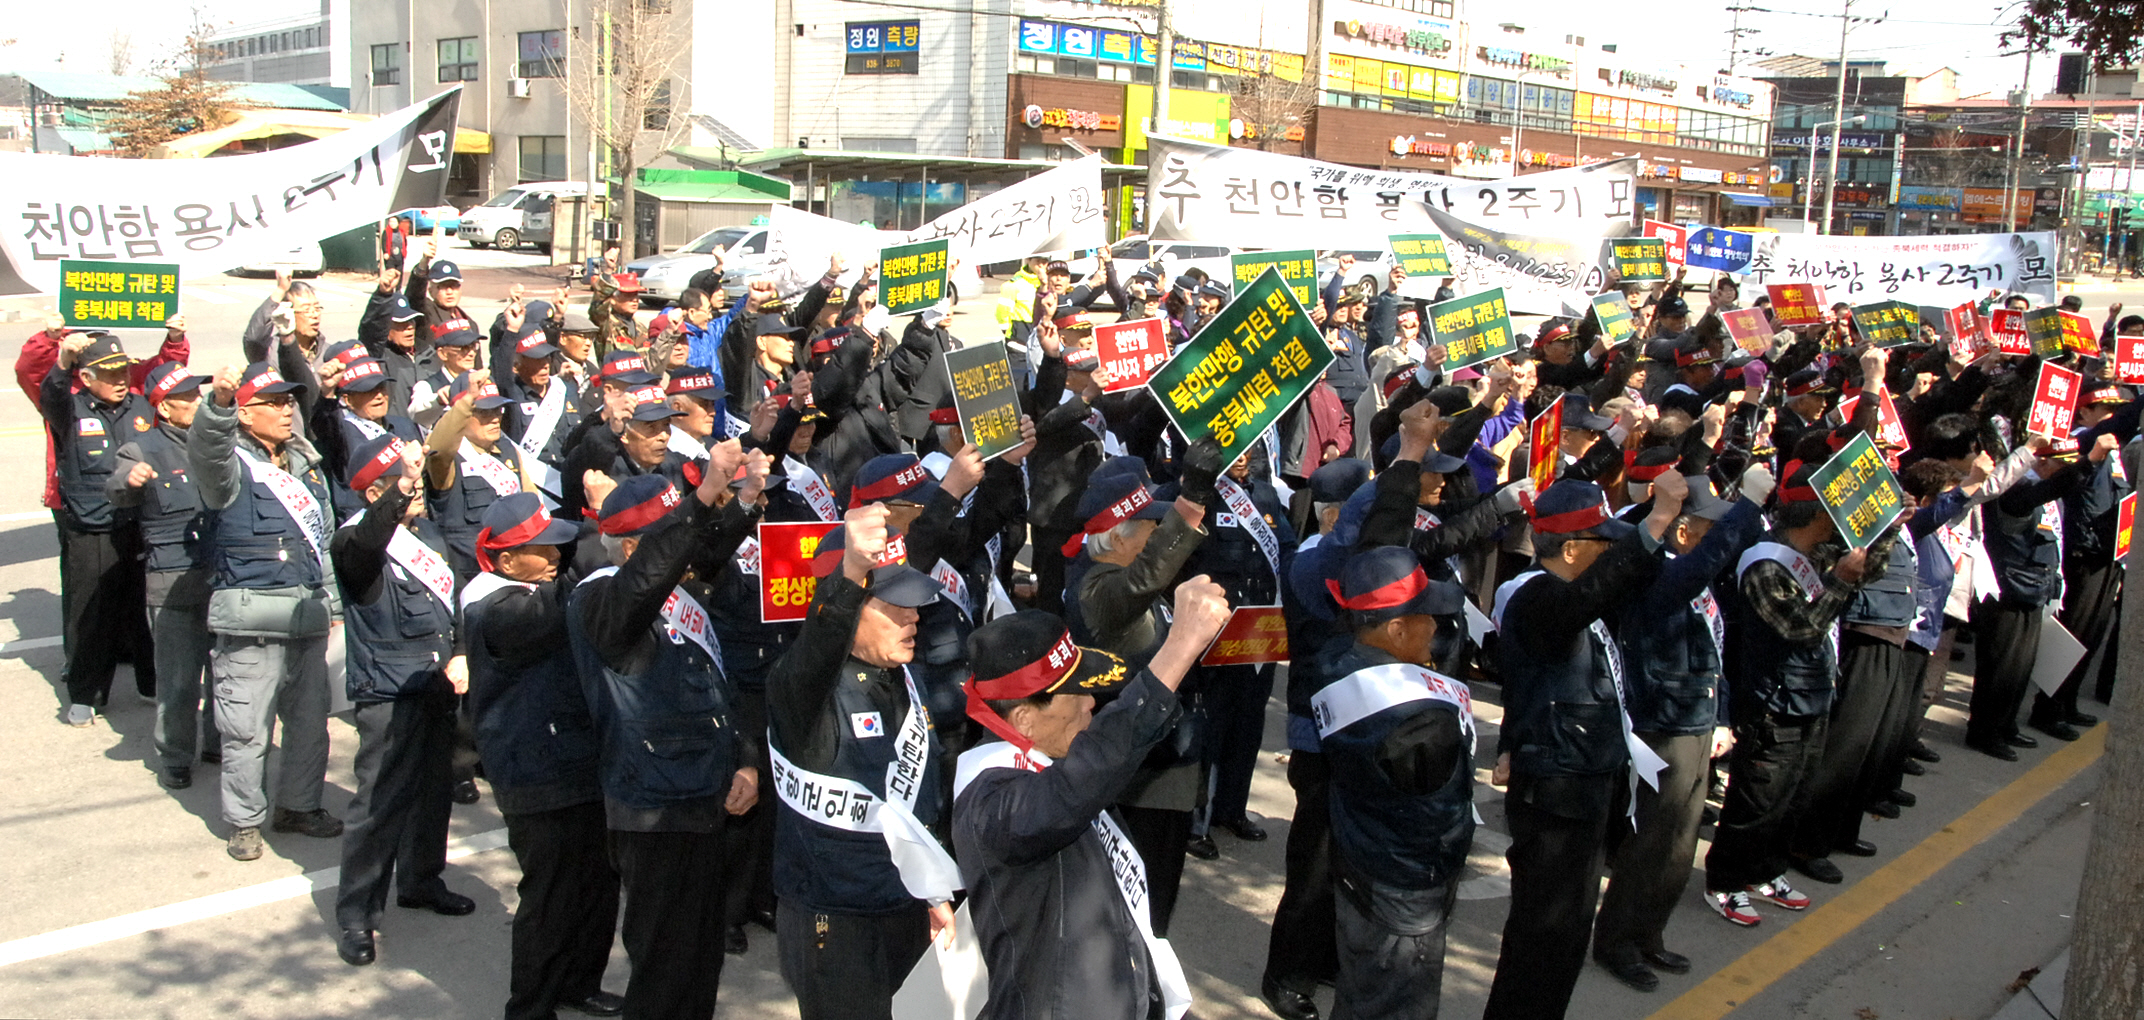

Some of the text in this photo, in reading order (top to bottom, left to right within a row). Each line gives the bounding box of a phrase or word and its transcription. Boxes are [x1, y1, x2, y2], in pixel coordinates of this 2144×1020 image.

[851, 26, 918, 49] 정원 측량
[1023, 22, 1093, 55] 정원
[1364, 22, 1404, 45] 아름다운
[1840, 138, 1868, 147] 사무소
[21, 129, 447, 260] 천안함 용사 2주기 모
[1159, 157, 1201, 224] 추
[1224, 177, 1350, 219] 천안함
[1478, 186, 1582, 219] 2주기
[1604, 179, 1631, 218] 모
[988, 195, 1055, 239] 2주기
[1069, 187, 1099, 224] 모
[883, 254, 919, 279] 북한만행
[919, 253, 938, 274] 규탄
[1614, 244, 1643, 259] 북한만행
[1642, 244, 1657, 258] 규탄
[65, 271, 175, 295] 북한만행 규탄 및
[1280, 259, 1314, 280] 규탄 및
[1752, 255, 2053, 293] 추 천안함 용사 2주기 모
[887, 279, 941, 308] 종북세력 척결
[73, 300, 165, 322] 종북세력 척결
[1435, 298, 1506, 335] 북한만행 규탄 및
[1115, 328, 1149, 353] 천안함
[1167, 288, 1296, 414] 북한만행 규탄 및
[1447, 326, 1507, 362] 종북세력 척결
[953, 359, 1012, 400] 북한만행 규탄 및
[1105, 356, 1141, 383] 전사자
[1207, 336, 1313, 447] 종북세력 척결
[970, 402, 1019, 447] 종북세력 척결
[895, 468, 917, 486] 북괴
[1822, 446, 1884, 507] 북한만행 규탄 및
[1111, 498, 1135, 519] 북괴
[1846, 480, 1898, 538] 종북세력 척결
[1047, 639, 1073, 670] 북괴
